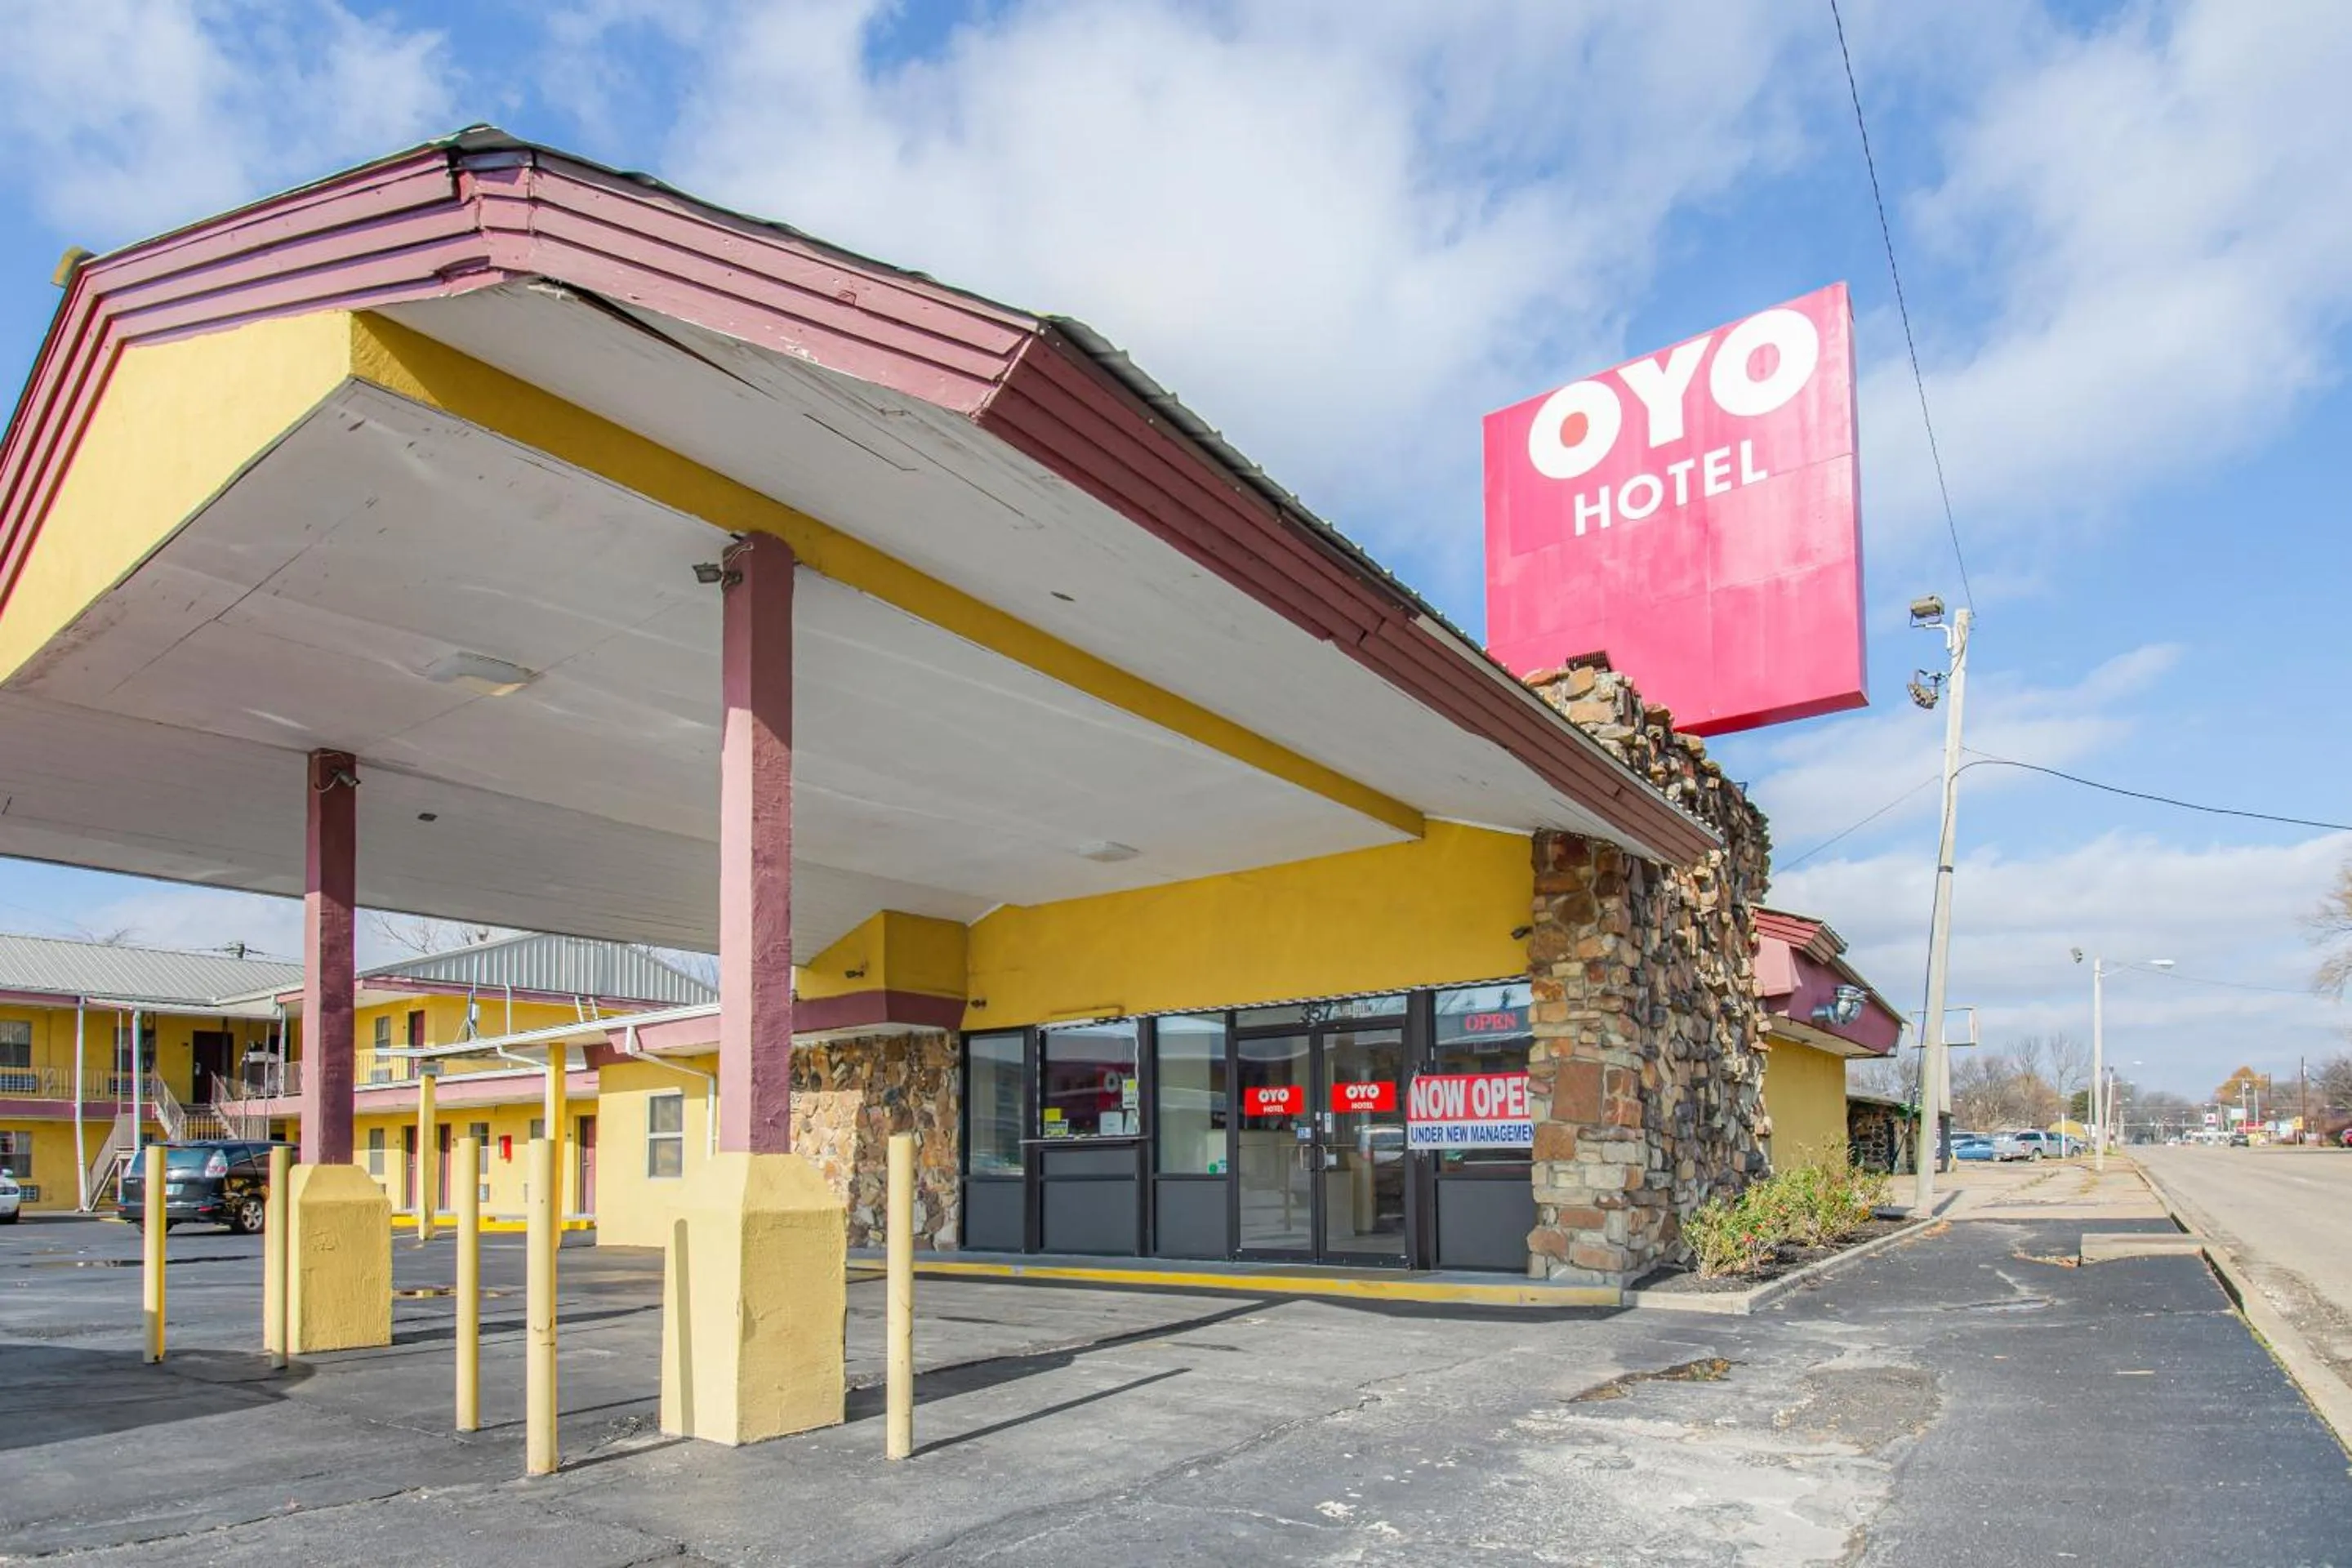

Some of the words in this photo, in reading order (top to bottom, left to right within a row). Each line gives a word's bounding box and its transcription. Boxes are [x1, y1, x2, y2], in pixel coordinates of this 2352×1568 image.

[1528, 308, 1820, 479] OYO
[1574, 439, 1768, 537] HOTEL
[1464, 1013, 1517, 1031] OPEN
[1258, 1088, 1290, 1103] OYO
[1345, 1084, 1380, 1100] OYO
[1410, 1078, 1467, 1119] NOW
[1263, 1104, 1285, 1114] HOTEL
[1351, 1101, 1375, 1110] HOTEL
[1410, 1126, 1444, 1143] UNDER
[1446, 1125, 1469, 1143] NEW
[1470, 1123, 1536, 1143] MANAGEMEN
